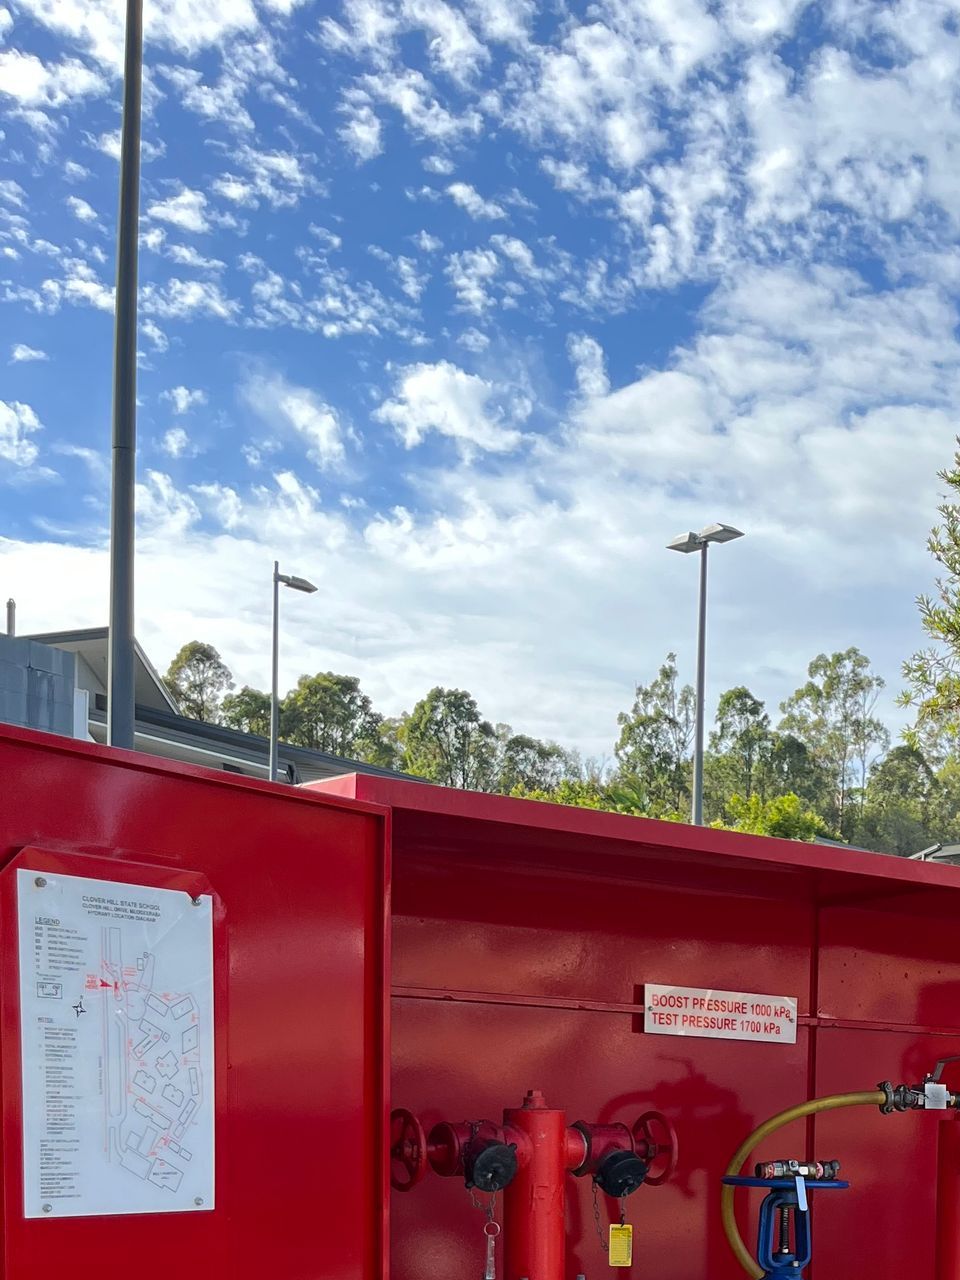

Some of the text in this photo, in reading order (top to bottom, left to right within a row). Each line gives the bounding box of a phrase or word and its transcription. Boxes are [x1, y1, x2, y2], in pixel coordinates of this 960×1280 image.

[82, 895, 106, 904] CLOVER
[120, 900, 137, 908] STATE
[138, 902, 160, 911] SCHOOL
[35, 916, 60, 926] LEGEND
[652, 994, 791, 1019] BOOST PRESSURE 1000 kPa
[652, 1012, 781, 1035] TEST PRESSURE 1700 kPa
